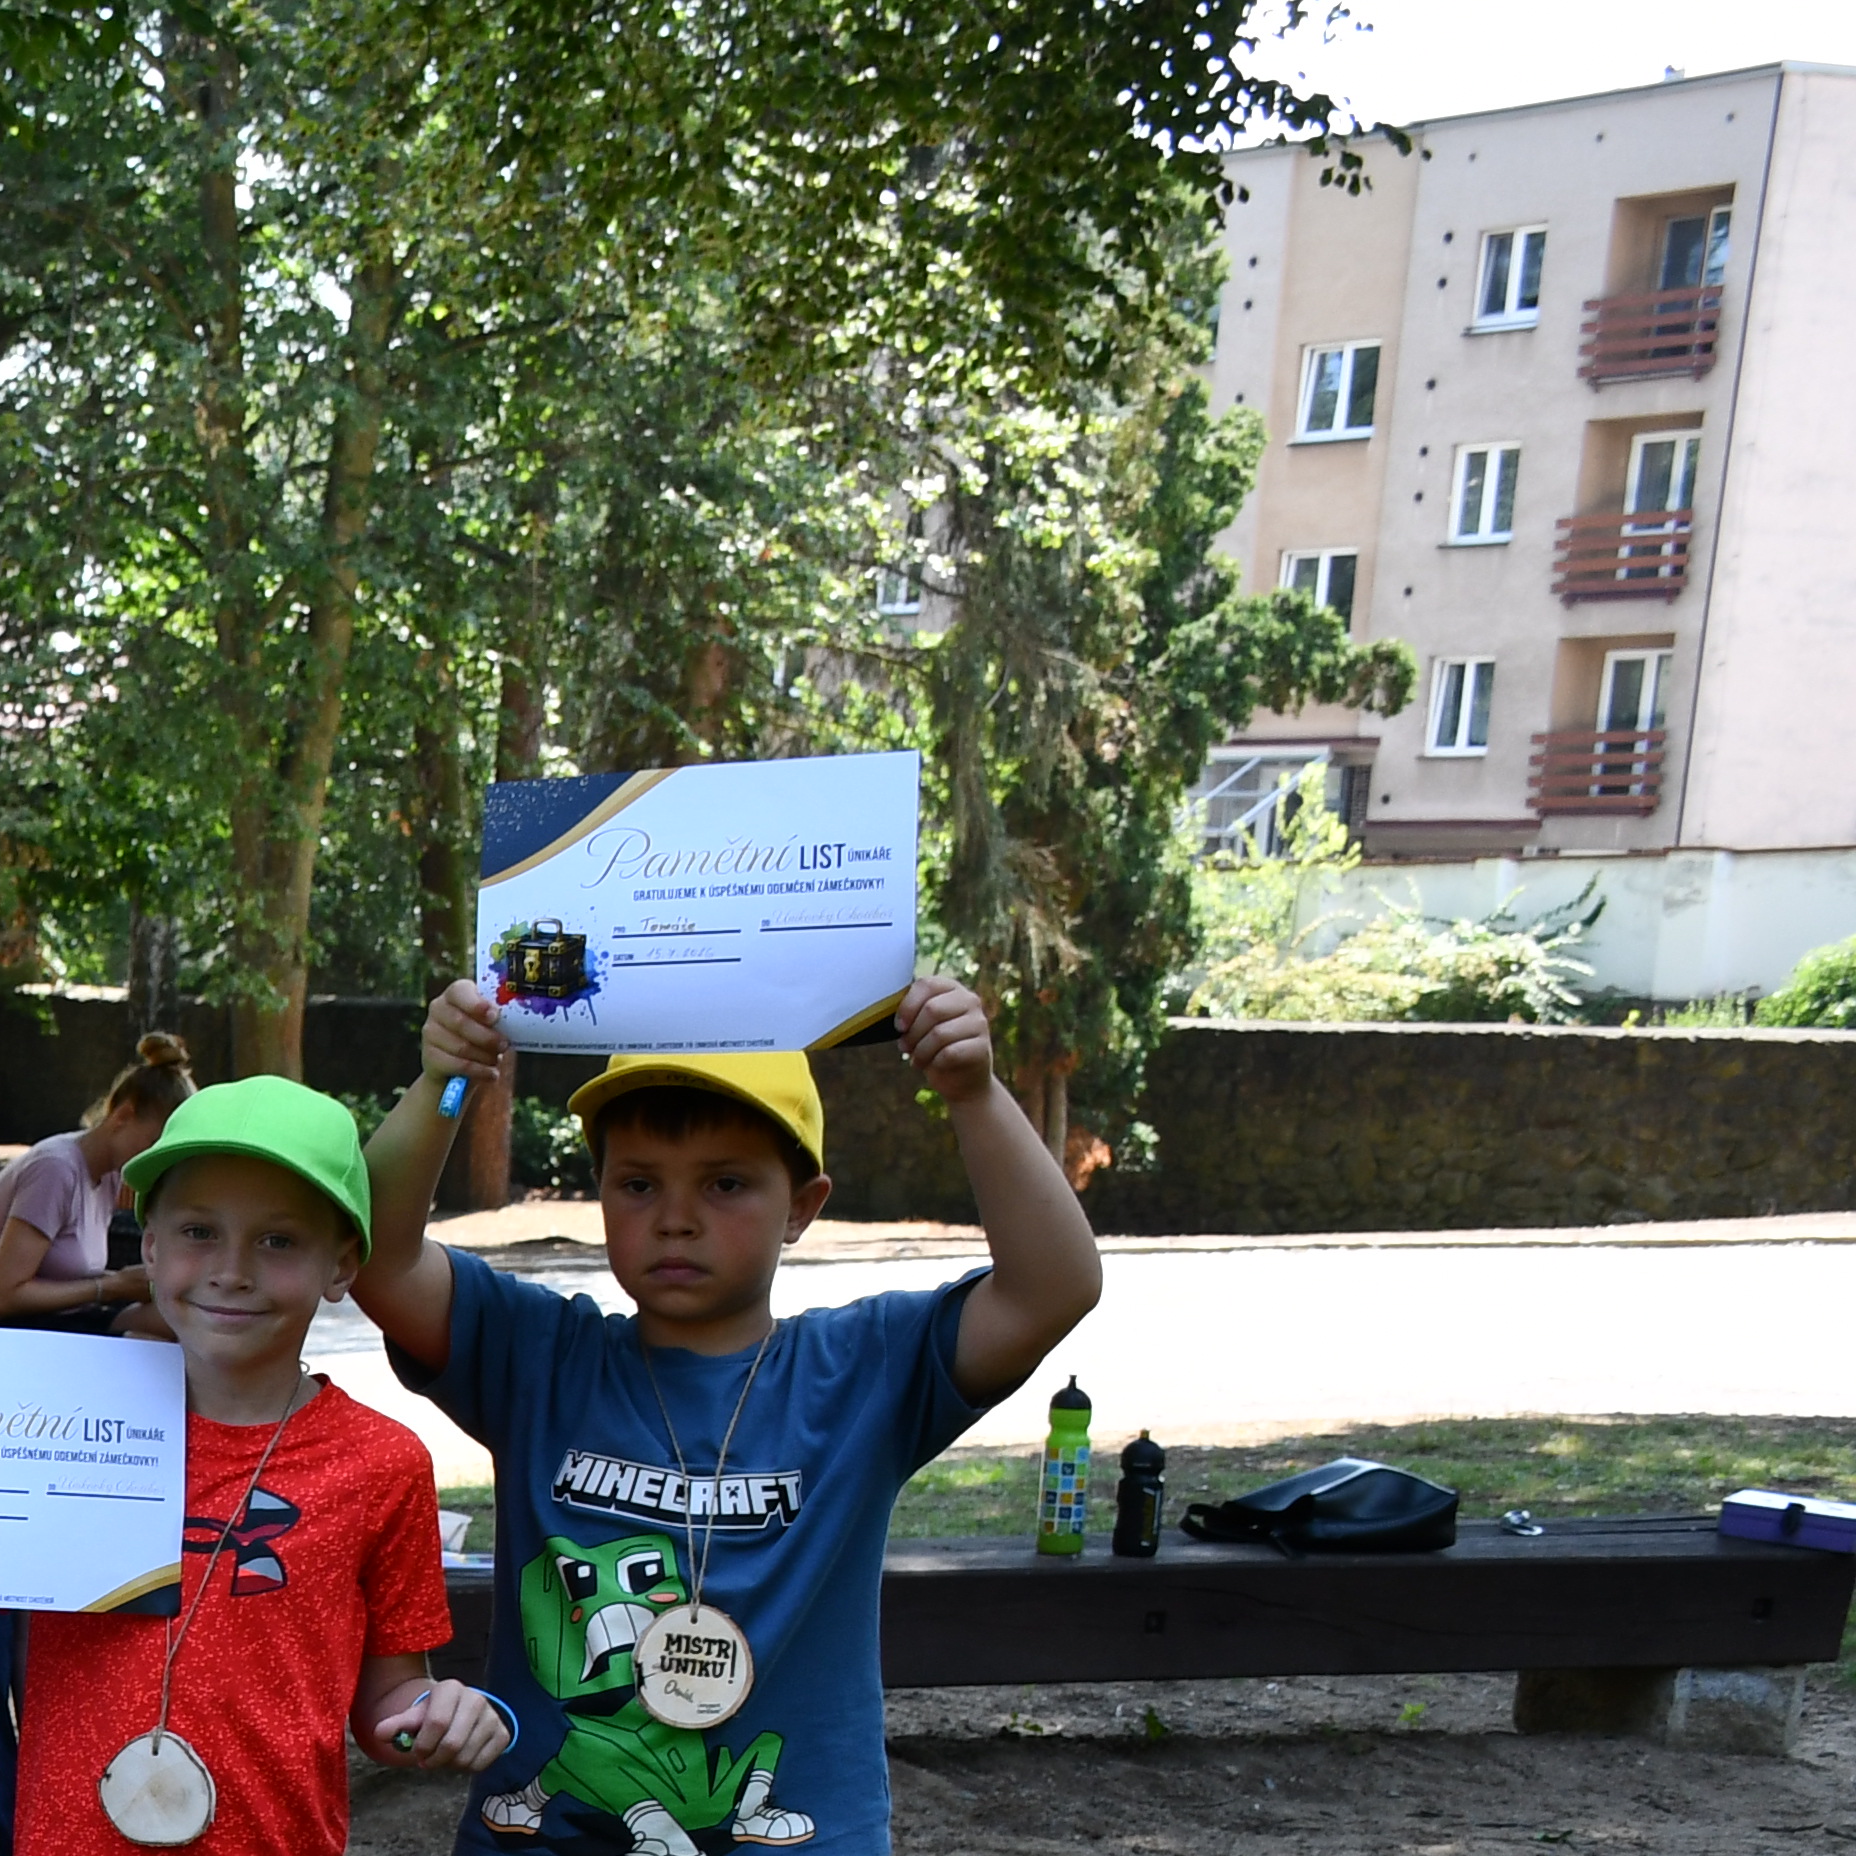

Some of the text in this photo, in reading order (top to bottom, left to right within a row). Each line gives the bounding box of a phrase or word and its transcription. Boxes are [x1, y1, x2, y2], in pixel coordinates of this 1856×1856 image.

[579, 822, 892, 889] Pamětní LIST ÚNIKÁŘE
[700, 887, 708, 899] K
[83, 1418, 125, 1444] LIST
[552, 1450, 802, 1526] MINECRAFT
[664, 1633, 731, 1659] MISTR
